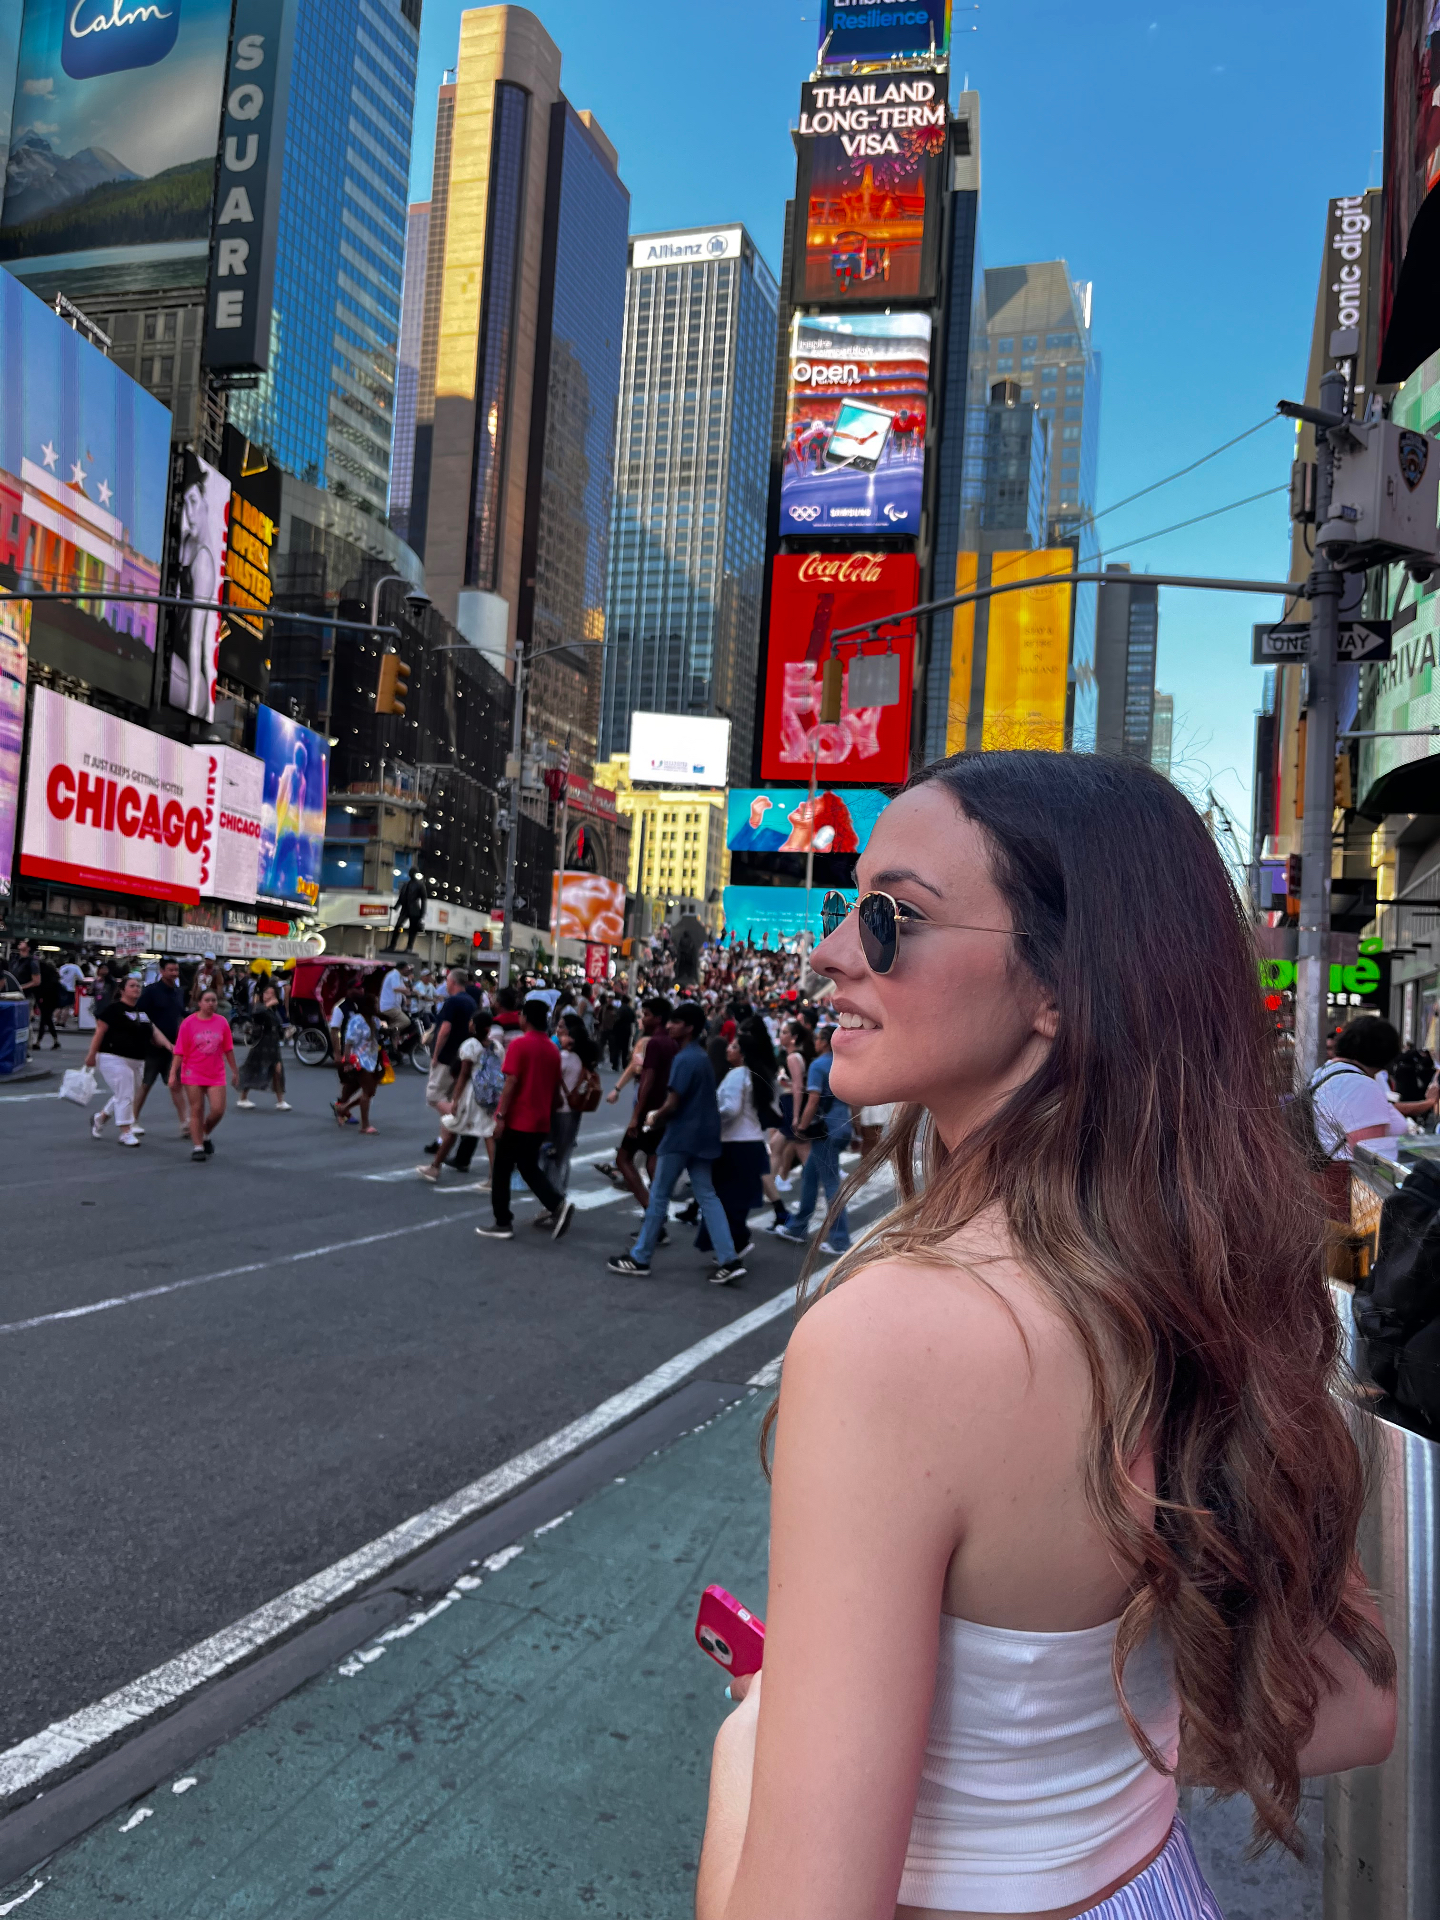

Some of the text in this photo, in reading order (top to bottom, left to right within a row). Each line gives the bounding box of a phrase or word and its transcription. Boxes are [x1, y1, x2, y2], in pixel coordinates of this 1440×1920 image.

[69, 0, 173, 39] Calm
[832, 8, 929, 30] Resilience
[811, 80, 936, 109] THAILAND
[798, 104, 946, 136] LONG-TERM
[840, 133, 900, 157] VISA
[214, 34, 266, 330] SQUARE
[646, 243, 703, 261] Allianz
[792, 362, 859, 387] Open
[1272, 635, 1310, 651] ONE
[46, 763, 205, 854] CHICAGO
[219, 811, 261, 839] CHICAGO
[590, 946, 607, 978] tkts
